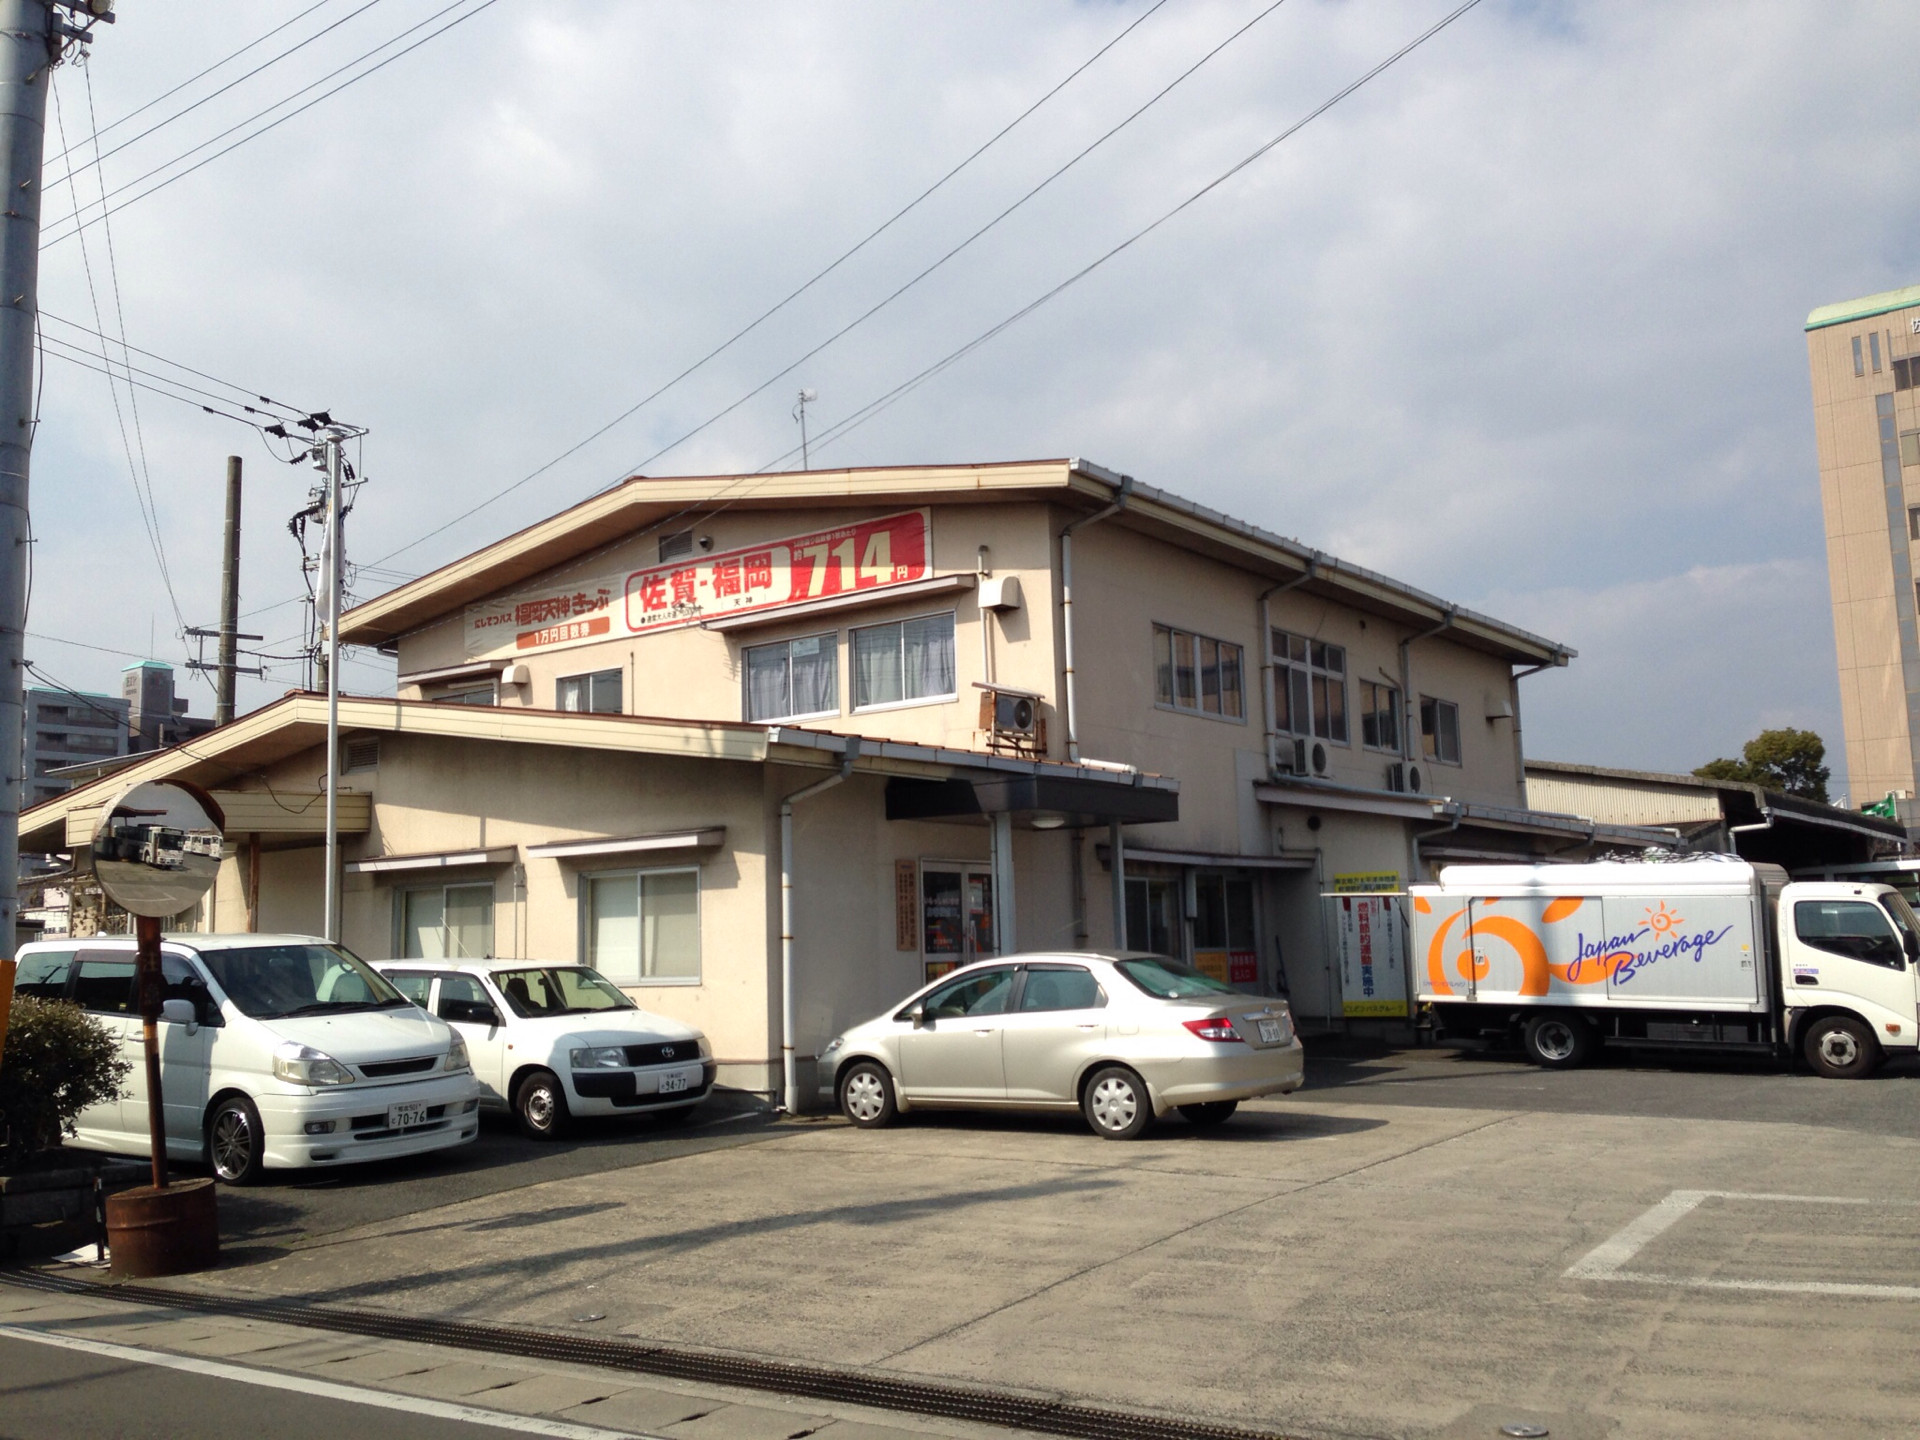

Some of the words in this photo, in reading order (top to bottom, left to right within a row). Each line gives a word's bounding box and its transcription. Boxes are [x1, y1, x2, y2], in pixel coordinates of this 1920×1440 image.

[803, 530, 895, 598] 714
[897, 564, 908, 579] 円
[474, 613, 512, 629] にしてつバス
[534, 622, 590, 645] 1万円回数券
[1357, 901, 1374, 998] 燃料節約運動実施中
[1567, 928, 1650, 982] Japan
[1604, 925, 1734, 986] Beverage
[397, 1110, 425, 1126] 70-76
